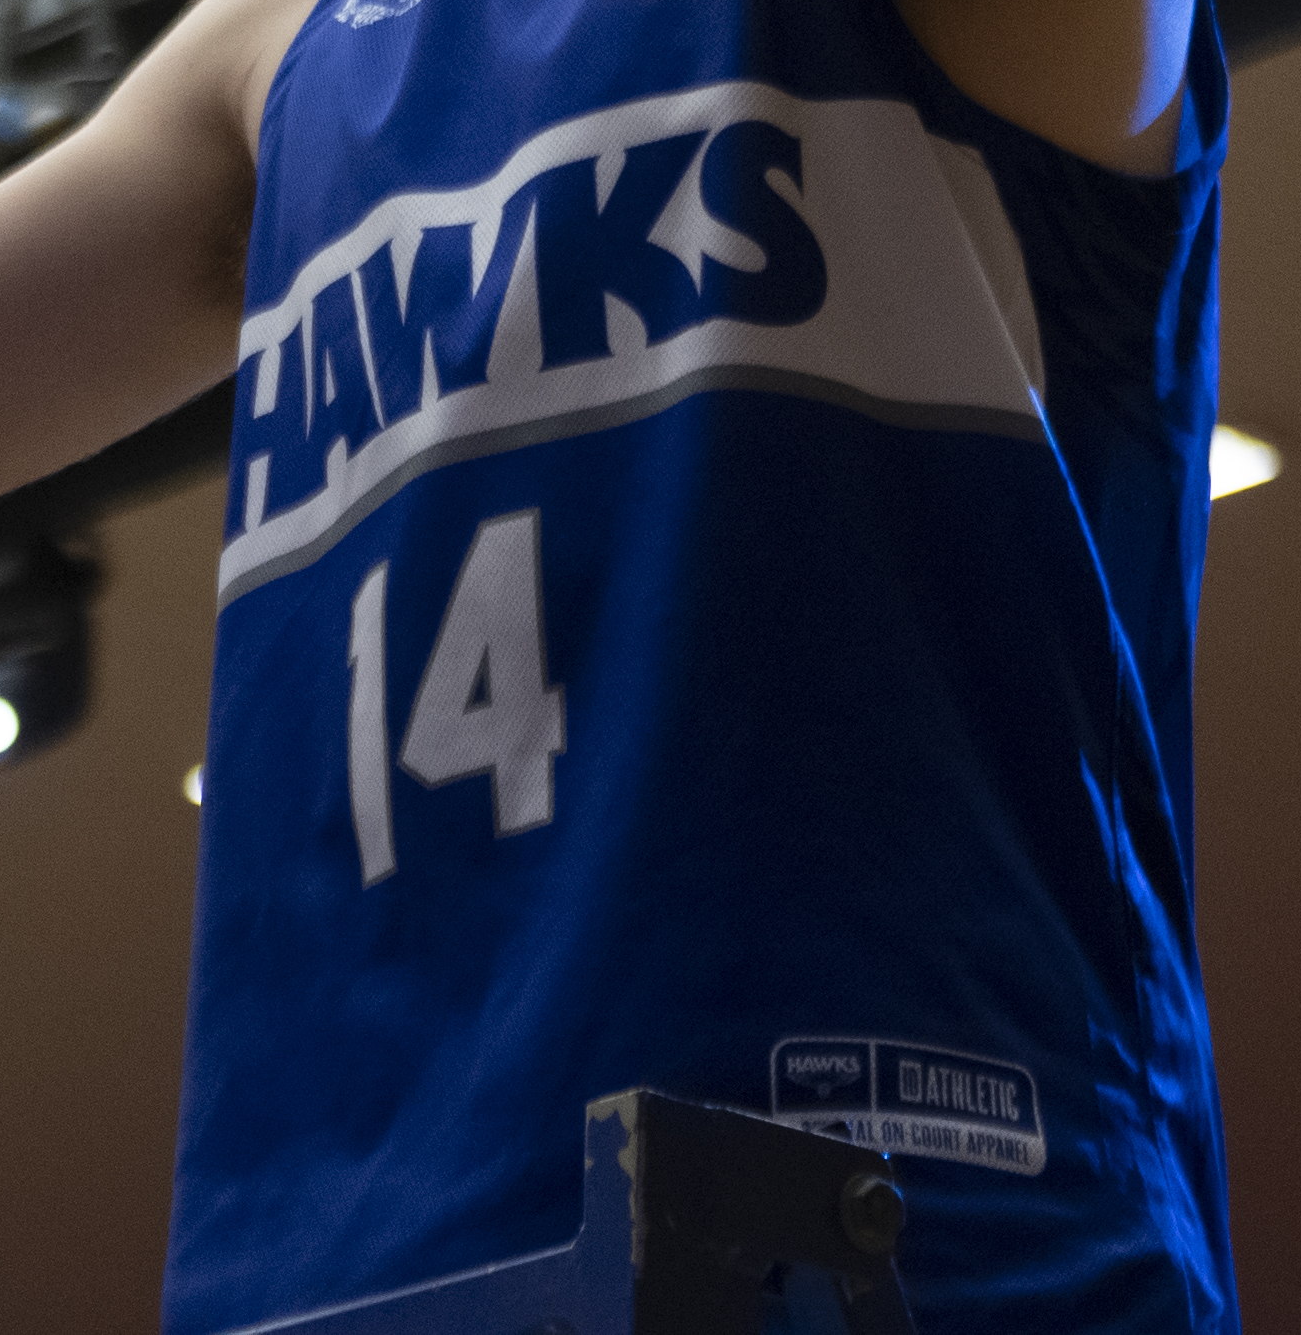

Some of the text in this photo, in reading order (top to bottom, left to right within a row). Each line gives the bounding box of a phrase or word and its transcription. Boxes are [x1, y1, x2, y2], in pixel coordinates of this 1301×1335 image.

[225, 120, 828, 534] HAWKS
[347, 507, 567, 889] 14
[787, 1056, 861, 1073] HAWKS
[926, 1066, 1019, 1121] ATHLETIC
[883, 1122, 905, 1146] ON
[911, 1124, 961, 1152] COURT
[967, 1131, 1028, 1164] APPAREL
